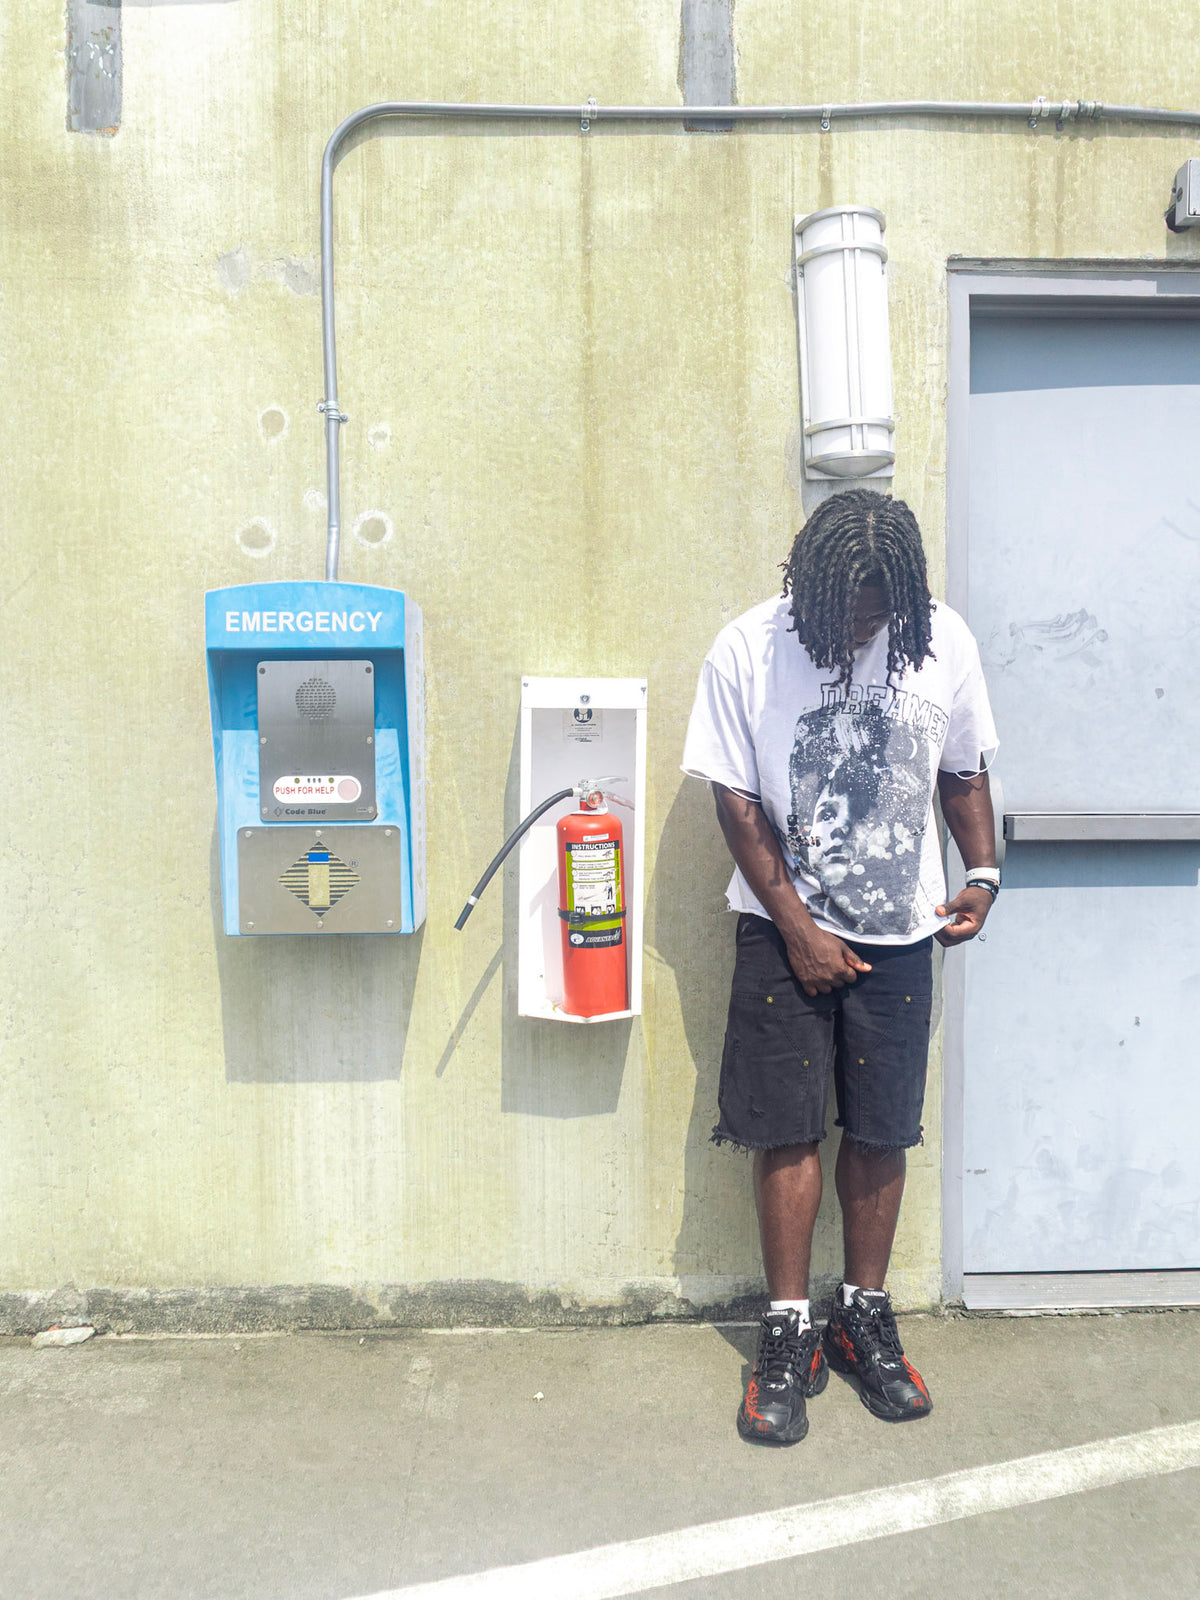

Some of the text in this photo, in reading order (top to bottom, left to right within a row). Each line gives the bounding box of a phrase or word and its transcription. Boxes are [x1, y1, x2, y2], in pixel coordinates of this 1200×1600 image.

[225, 611, 382, 632] EMERGENCY
[275, 786, 335, 795] PUSH FOR HELP
[571, 841, 616, 850] INSTRUCTIONS
